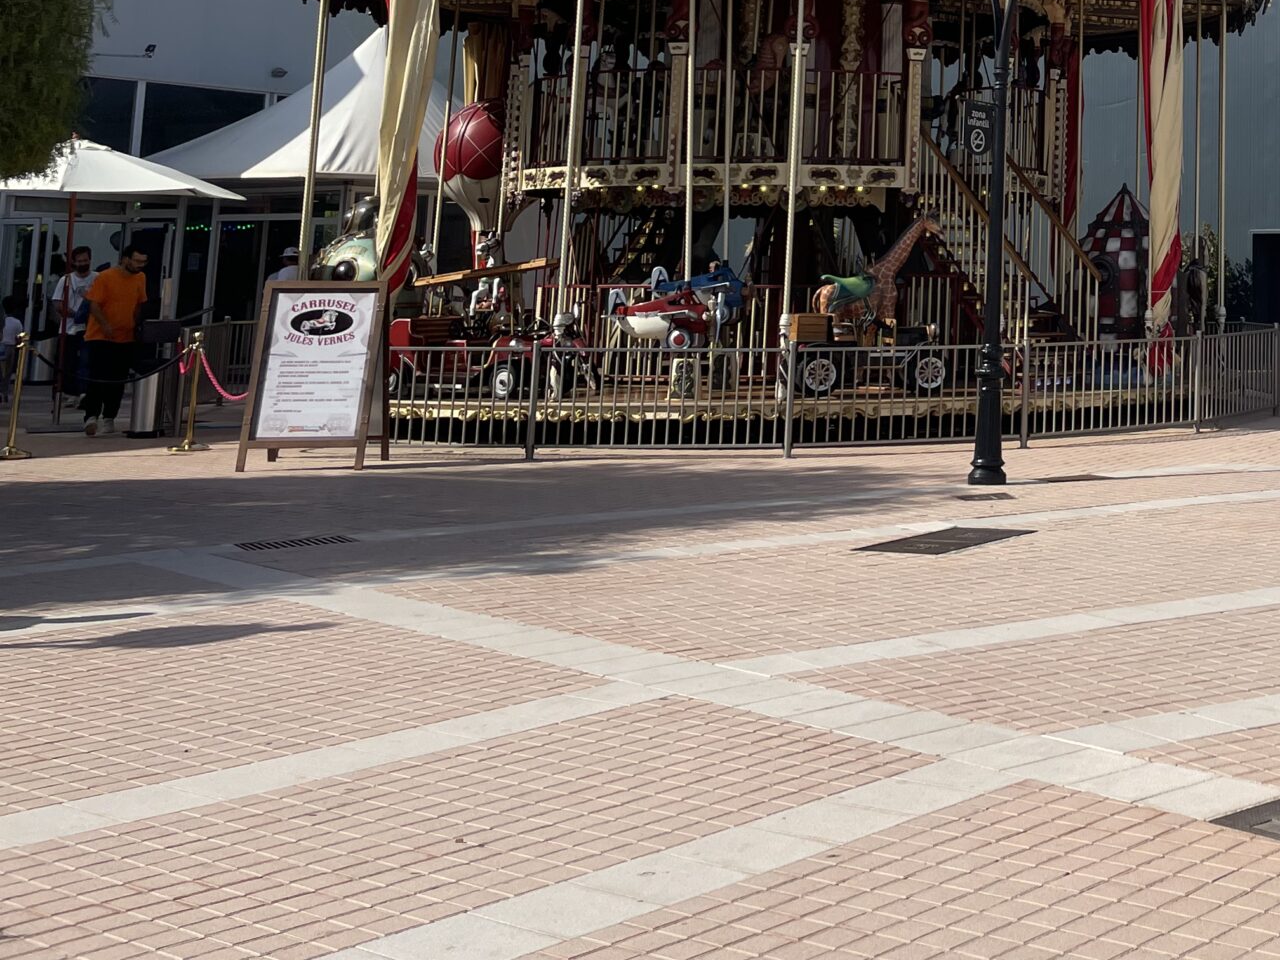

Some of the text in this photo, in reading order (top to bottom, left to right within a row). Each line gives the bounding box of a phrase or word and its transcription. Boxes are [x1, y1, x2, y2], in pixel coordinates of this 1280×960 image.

[971, 110, 986, 119] zona
[967, 116, 990, 129] infantil
[291, 298, 357, 313] CARRUSEL
[284, 331, 356, 346] JULES VERNES
